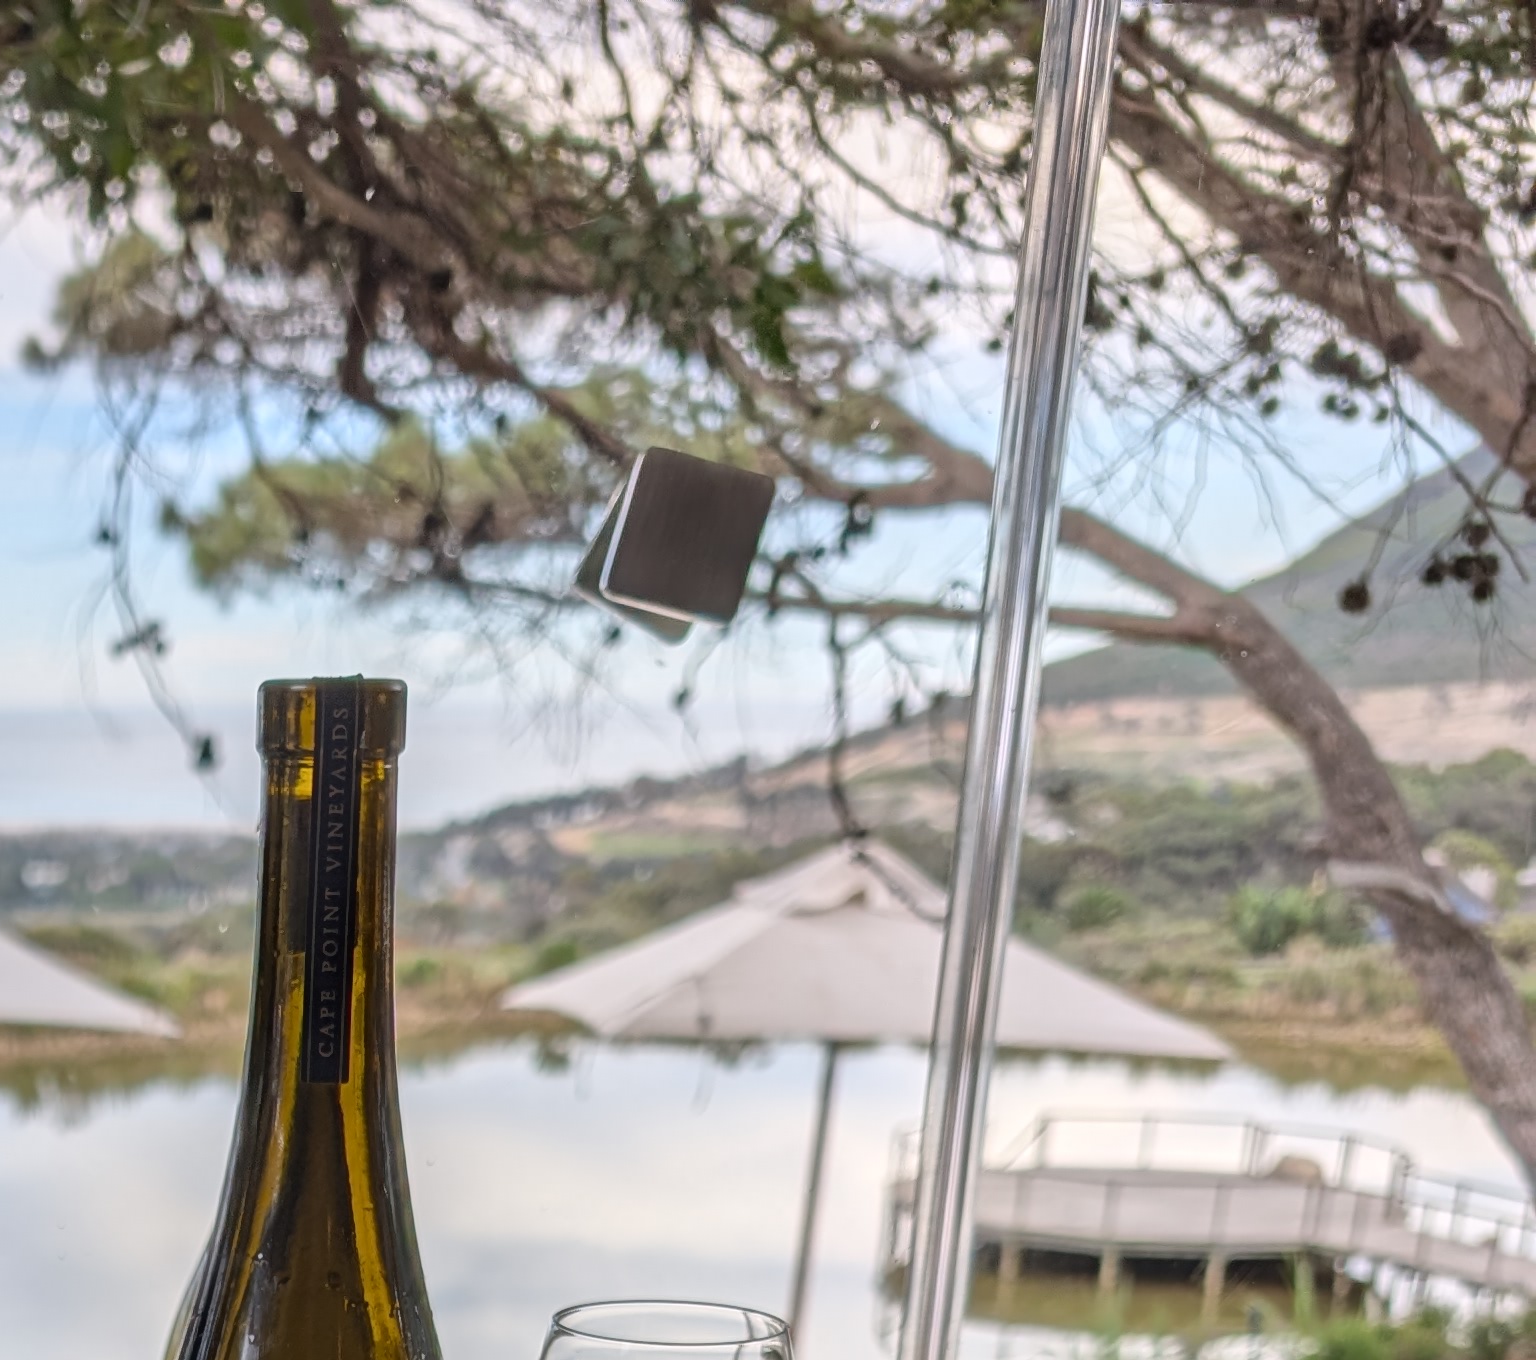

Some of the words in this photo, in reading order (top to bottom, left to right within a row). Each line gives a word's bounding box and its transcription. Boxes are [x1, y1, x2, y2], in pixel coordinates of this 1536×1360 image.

[325, 706, 350, 873] VINEYARDS
[322, 887, 342, 973] POINT
[318, 989, 337, 1058] CAPE
